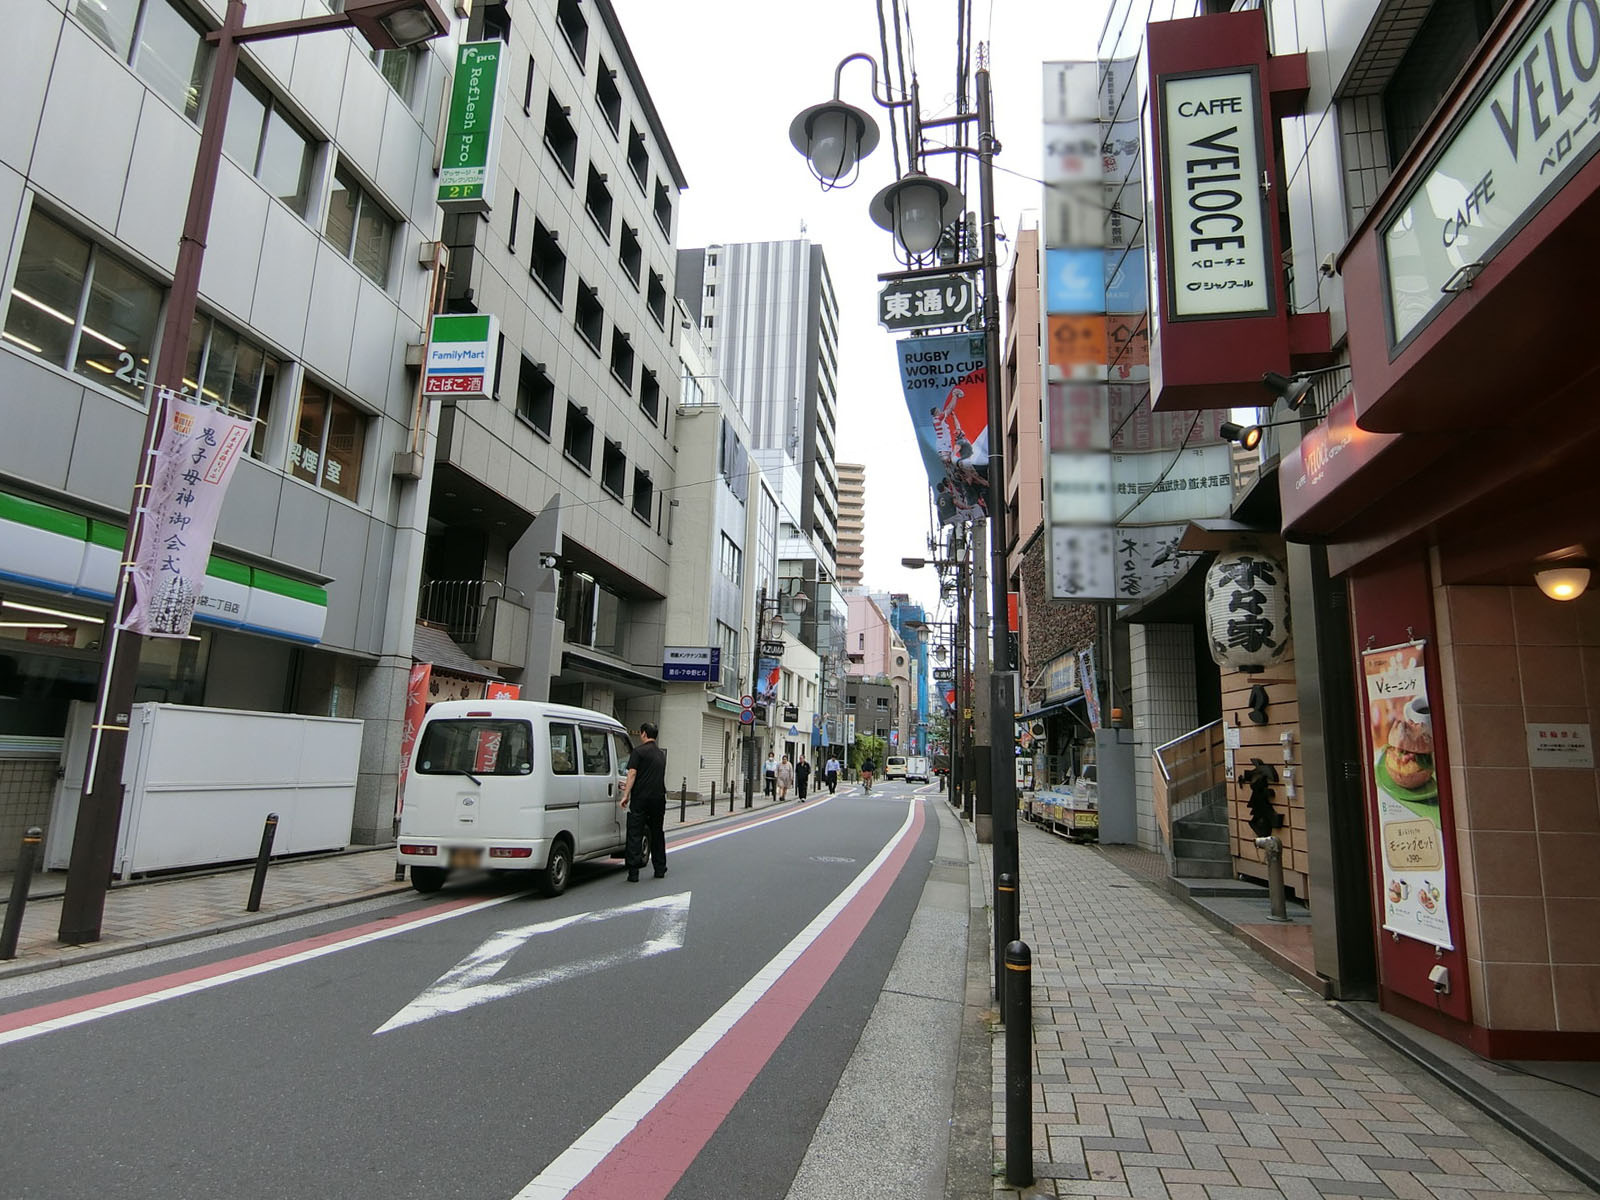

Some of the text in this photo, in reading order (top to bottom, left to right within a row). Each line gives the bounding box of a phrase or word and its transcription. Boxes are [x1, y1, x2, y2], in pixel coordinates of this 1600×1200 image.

[464, 67, 482, 130] Reflesh
[1178, 97, 1243, 117] CAFFE
[1187, 126, 1245, 252] VELOCE
[1442, 169, 1496, 248] CAFFE
[1192, 258, 1246, 269] ベローチェ
[1203, 279, 1254, 291] シャノアール
[884, 285, 968, 320] 東通り
[432, 350, 485, 361] FamilyMart
[905, 350, 950, 364] RUGBY
[115, 352, 147, 387] 2F
[905, 360, 984, 377] WORLD CUP
[907, 373, 985, 390] 2019, JAPAN
[159, 426, 217, 576] 鬼子母神御会式
[762, 645, 784, 657] AZUMA
